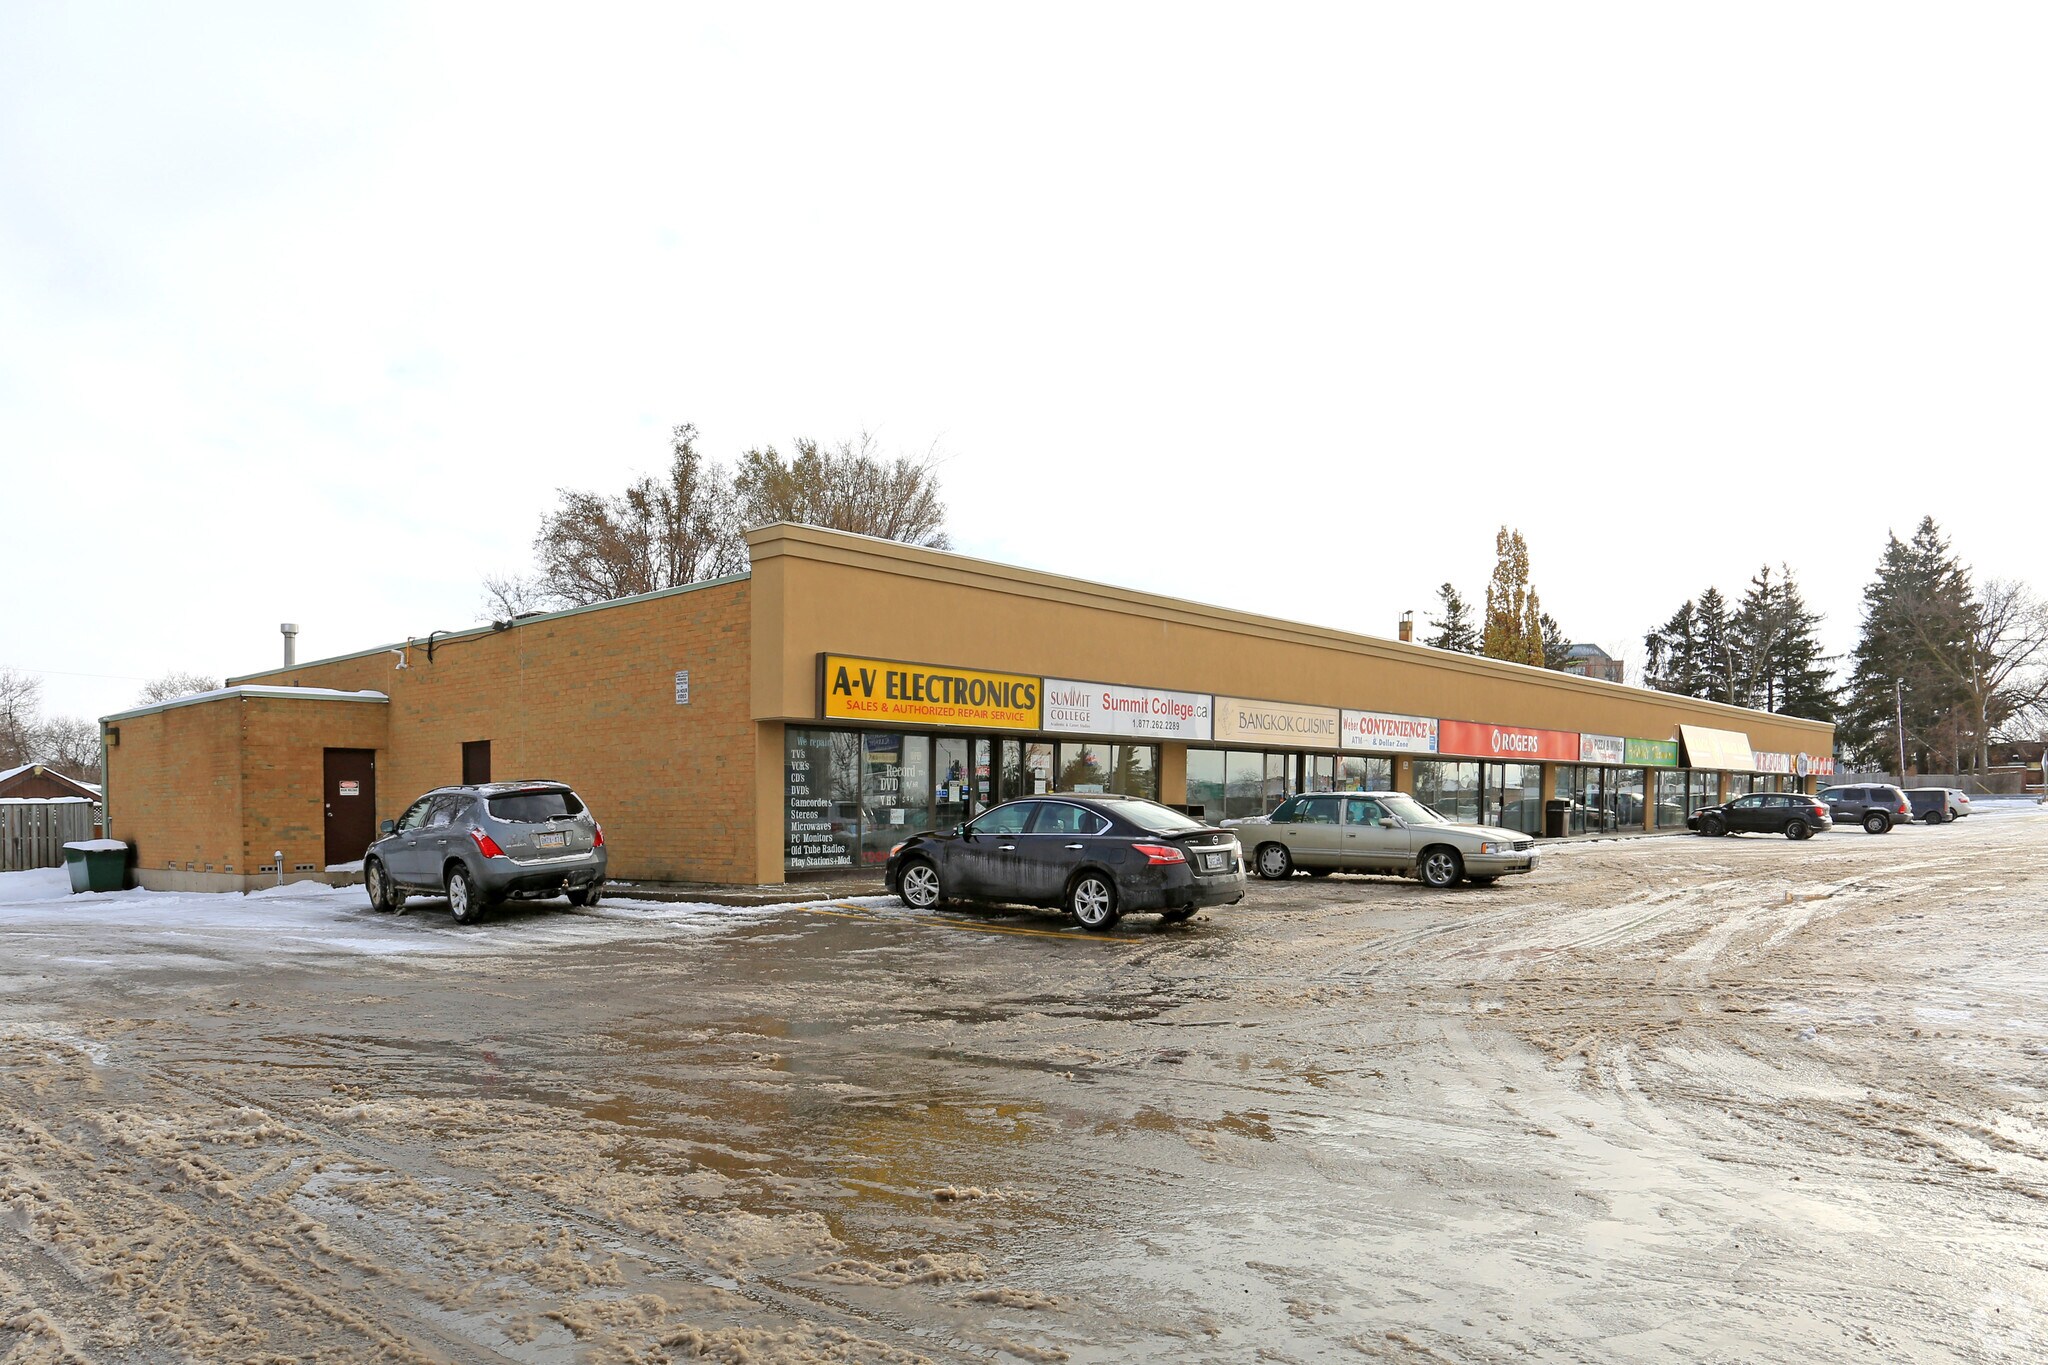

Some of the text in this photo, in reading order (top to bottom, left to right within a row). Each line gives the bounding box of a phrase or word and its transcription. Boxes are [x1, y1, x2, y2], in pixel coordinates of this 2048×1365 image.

[833, 666, 1036, 710] A-V ELECTRONICS
[1051, 686, 1091, 708] SUMMIT
[846, 700, 1024, 722] SALES & AUTHORIZED REPAIR SERVICE
[1102, 693, 1207, 720] Summit College.ca
[1051, 710, 1090, 721] COLLEGE
[1133, 720, 1180, 730] 1.877.262.2289
[1238, 712, 1334, 735] BANGKOK CUISINE
[1344, 717, 1427, 738] Weber CONVENIENCE
[797, 737, 807, 745] We
[1352, 736, 1362, 745] ATM
[1379, 738, 1394, 747] Dollar
[1502, 734, 1538, 752] ROGERS
[791, 750, 805, 758] TV's
[791, 761, 809, 770] VCR's
[886, 764, 915, 777] Record
[791, 773, 805, 782] CD's
[880, 778, 898, 791] DVD
[791, 785, 809, 795] DVD's
[791, 798, 832, 807] Camcorders
[880, 796, 896, 806] VHS
[791, 810, 818, 819] Stereos
[791, 822, 831, 831] Microwaves
[791, 833, 832, 843] PC Monitors
[791, 844, 845, 855] Old Tube Radios
[791, 858, 805, 868] Play
